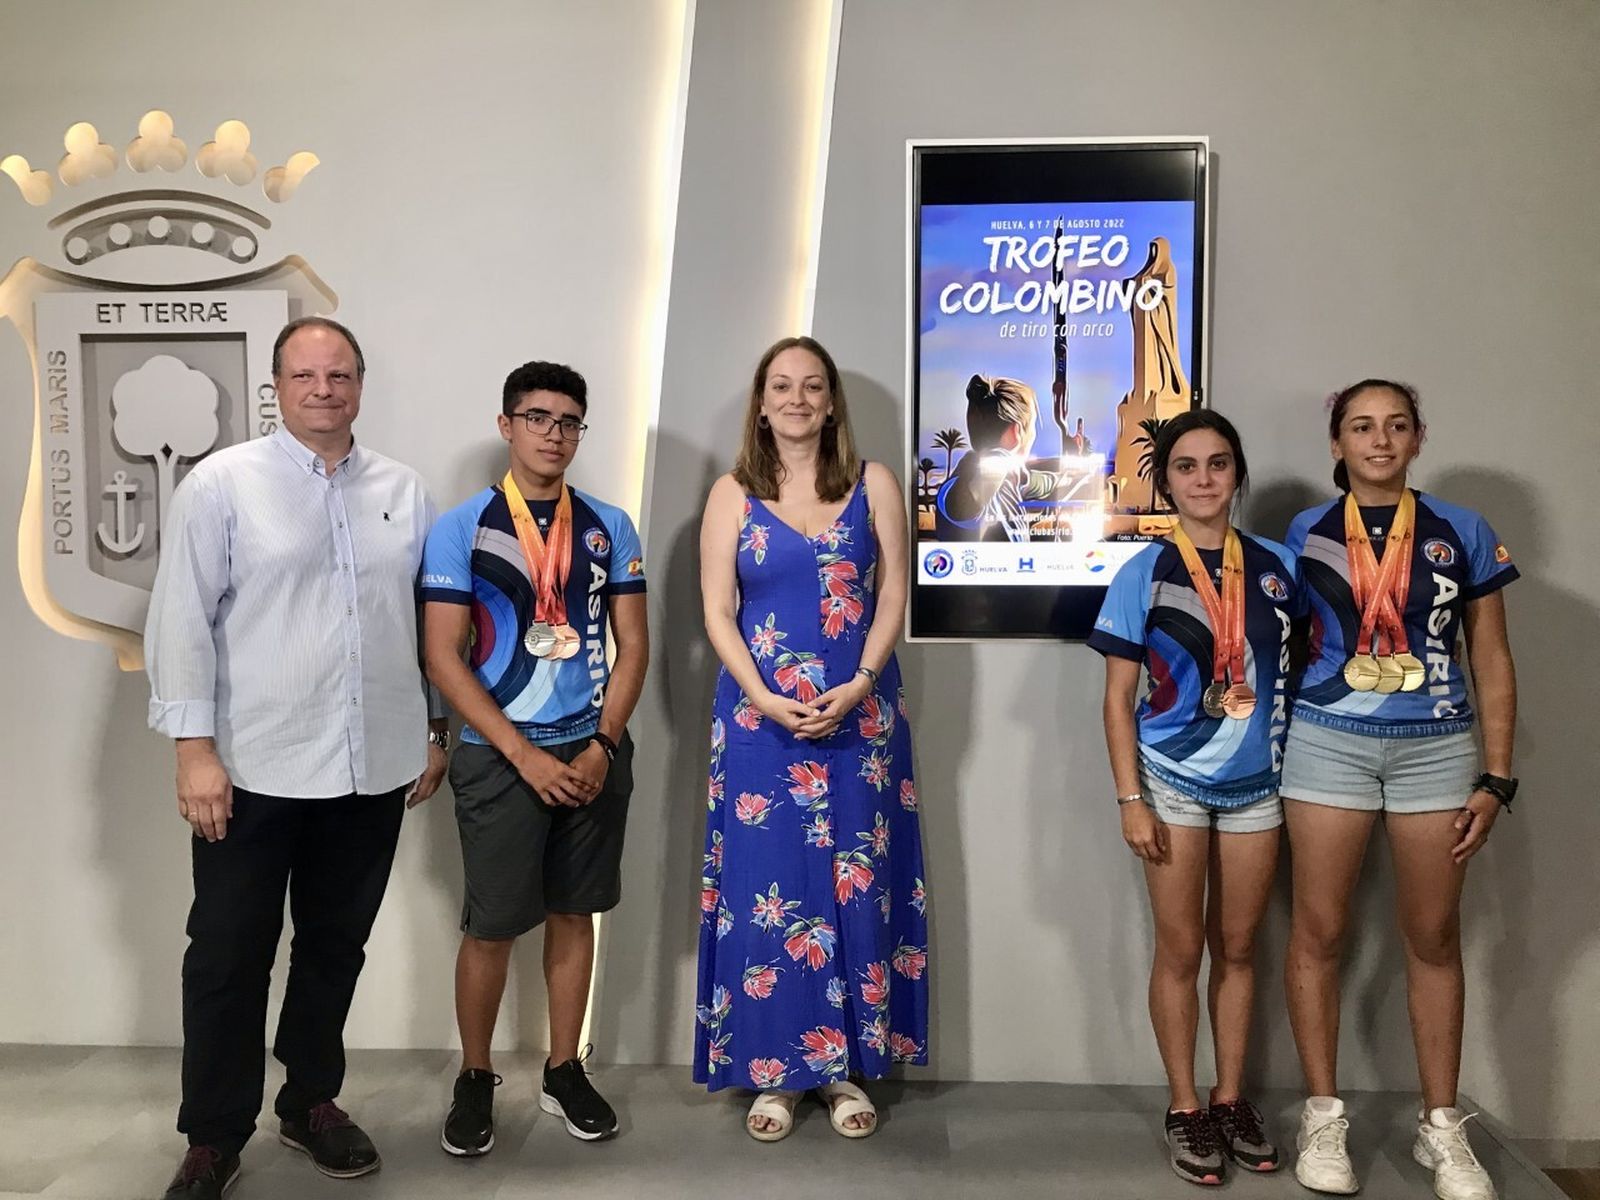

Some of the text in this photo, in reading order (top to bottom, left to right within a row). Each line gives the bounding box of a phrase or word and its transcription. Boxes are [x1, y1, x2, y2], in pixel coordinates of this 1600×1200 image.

[990, 218, 1125, 231] HUELVA, 6 Y 7 DE AGOSTO 2022
[983, 234, 1130, 274] TROFEO
[97, 301, 228, 323] ET TERRÆ
[939, 278, 1164, 315] COLOMBINO
[1000, 321, 1114, 338] de tiro con arco
[48, 350, 74, 555] PORTUS MARIS
[586, 562, 608, 708] ASIRIO
